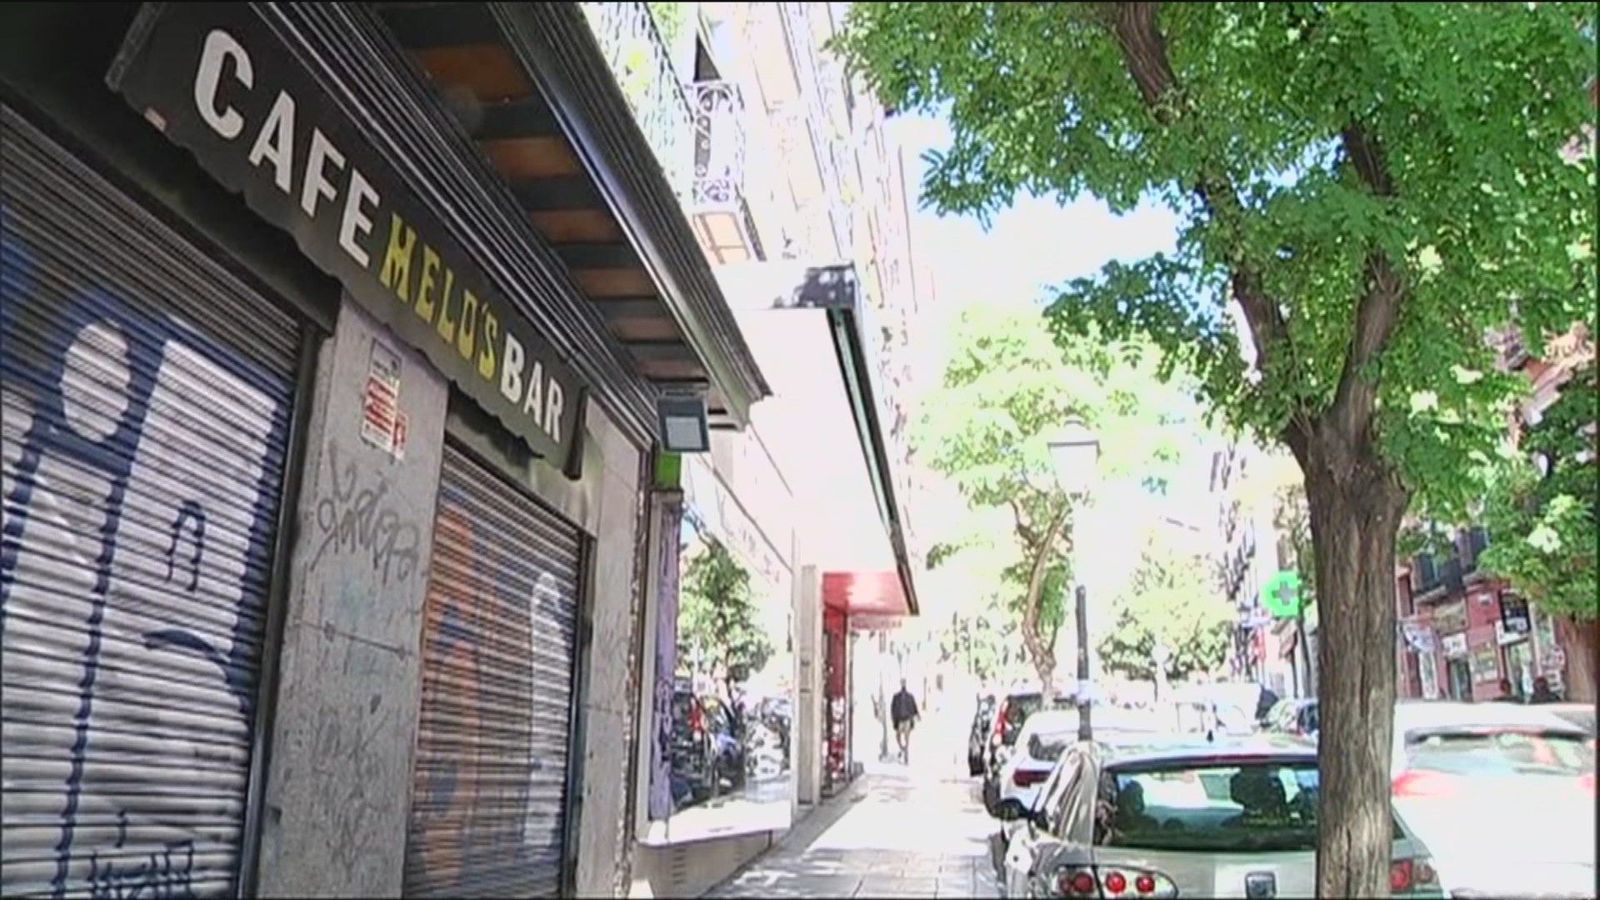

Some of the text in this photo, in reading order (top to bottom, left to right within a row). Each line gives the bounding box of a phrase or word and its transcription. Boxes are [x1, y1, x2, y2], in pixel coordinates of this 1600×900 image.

[195, 29, 380, 268] CAFE
[379, 213, 497, 380] MELO'S
[501, 332, 563, 443] BAR
